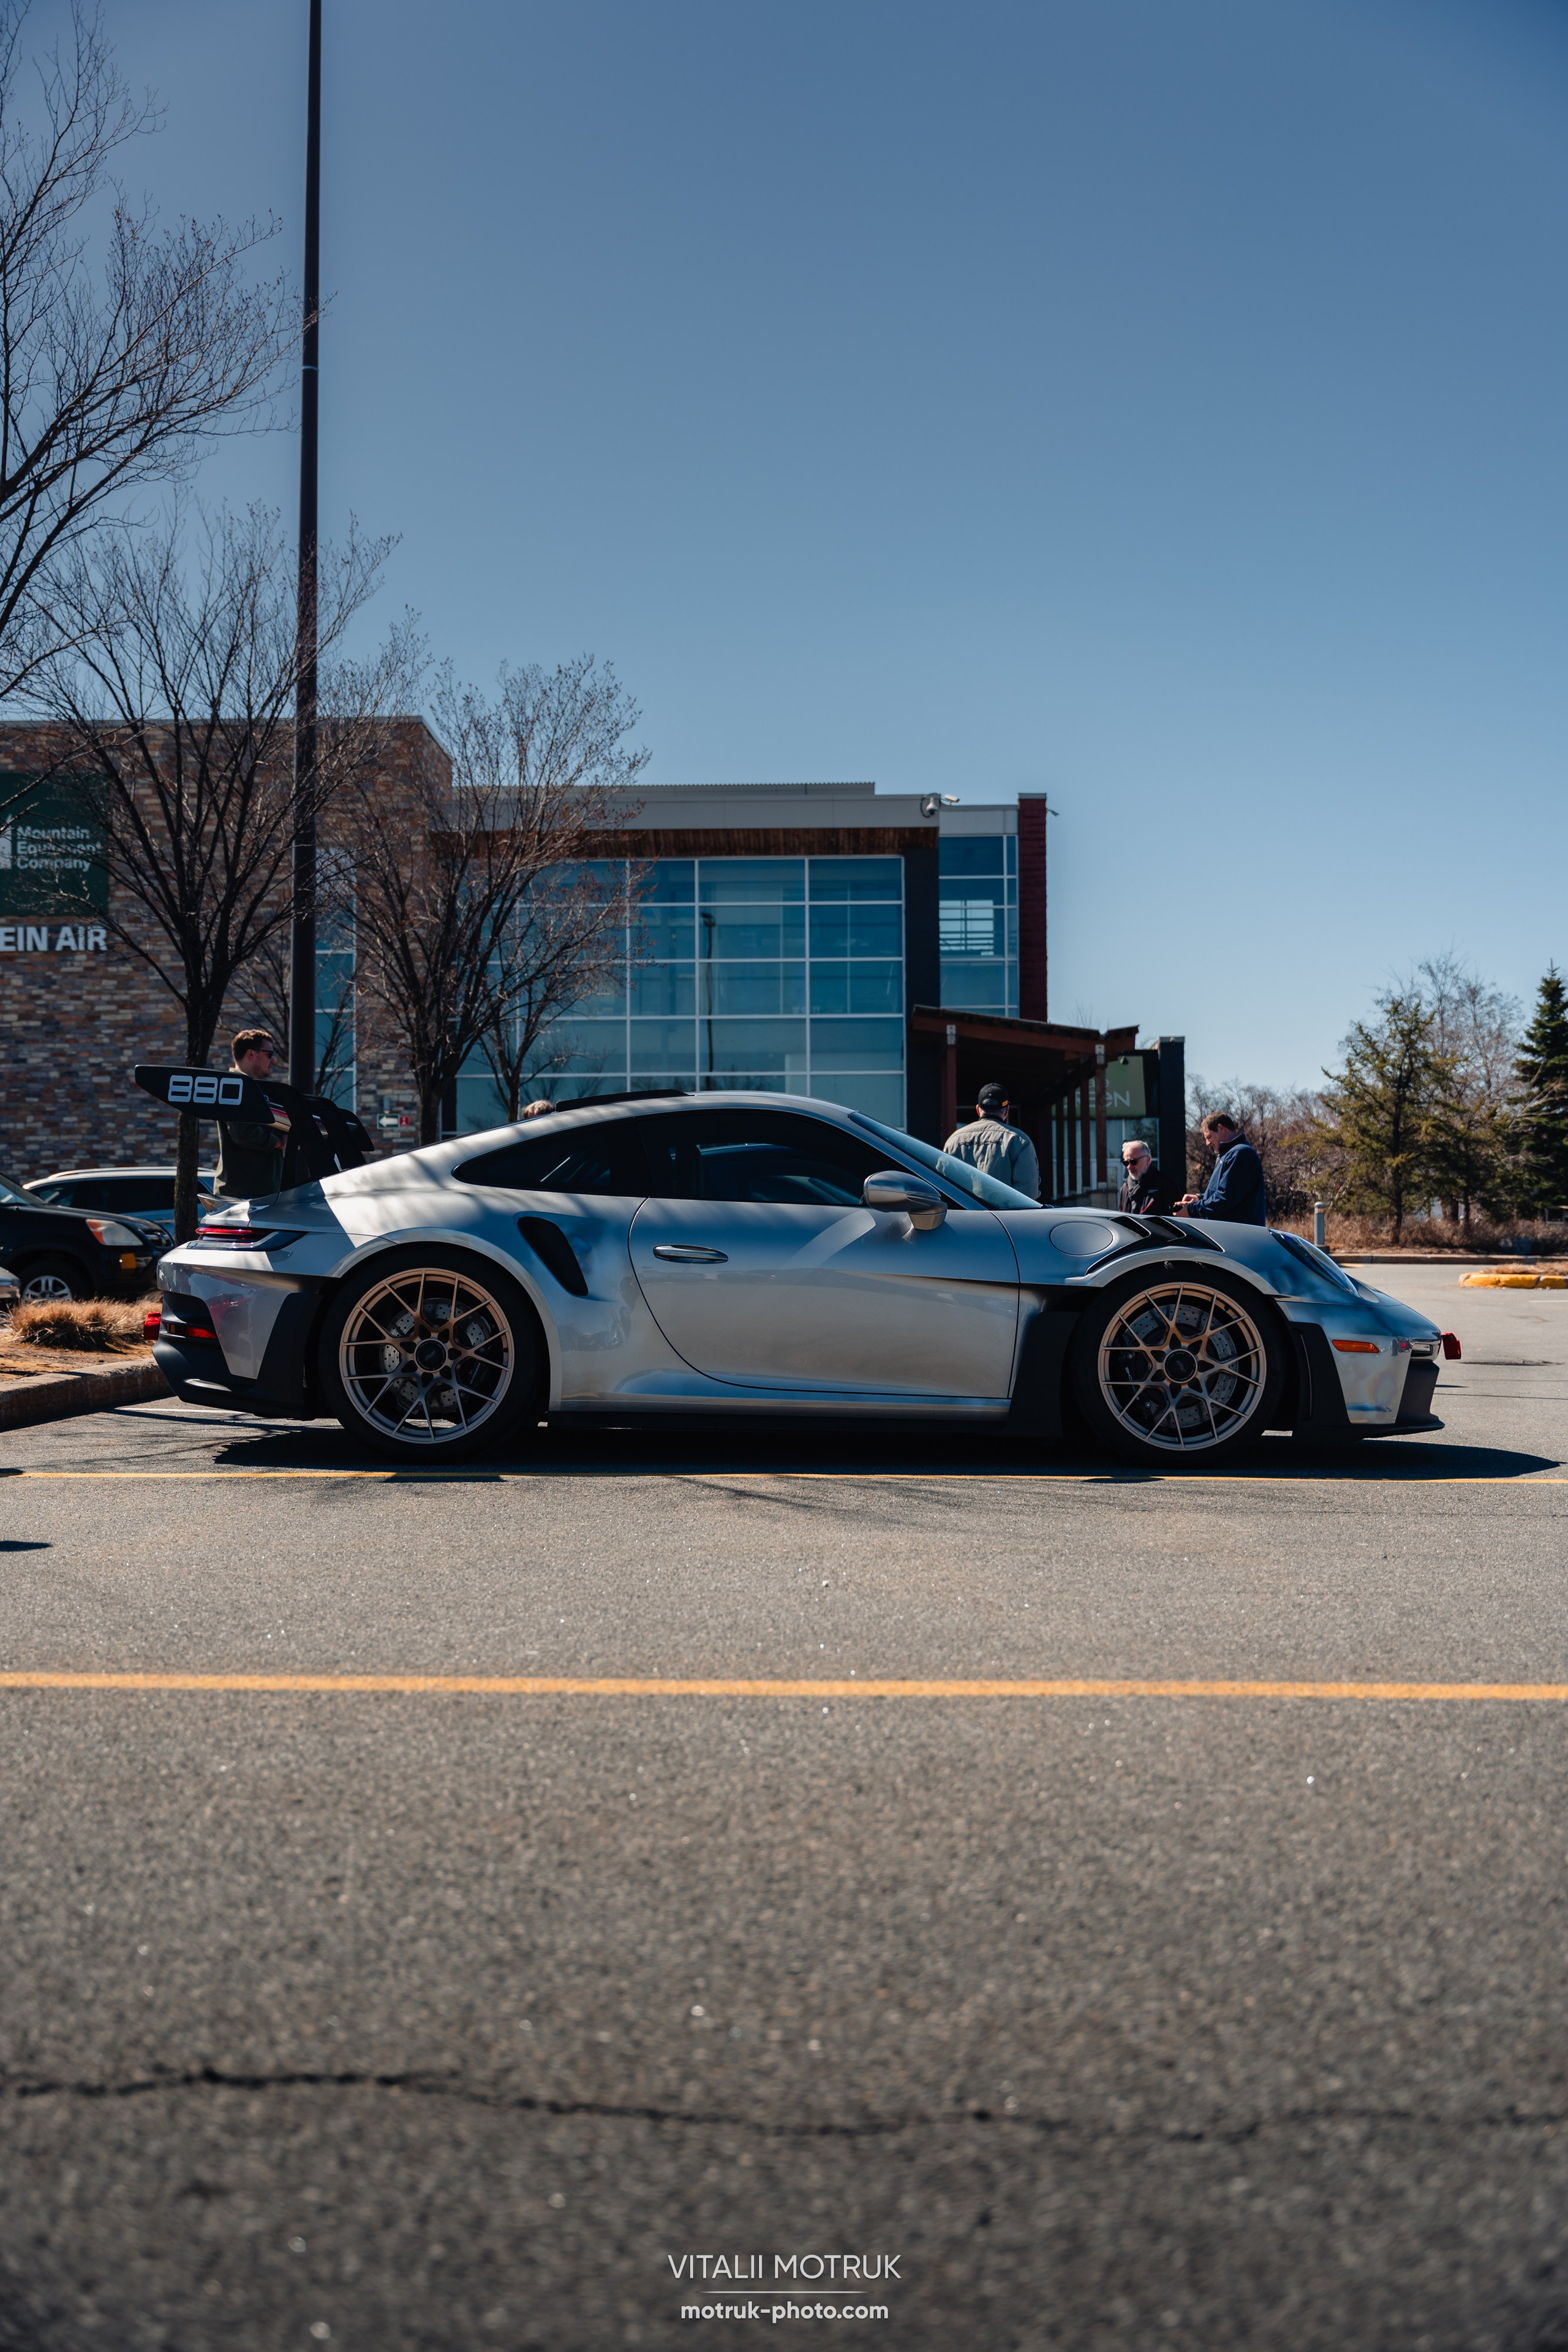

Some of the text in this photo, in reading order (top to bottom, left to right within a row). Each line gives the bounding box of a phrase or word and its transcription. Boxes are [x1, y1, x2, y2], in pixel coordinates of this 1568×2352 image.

[17, 826, 90, 839] Mountain
[17, 857, 91, 872] Company
[0, 926, 107, 951] EIN AIR
[168, 1075, 243, 1106] 880
